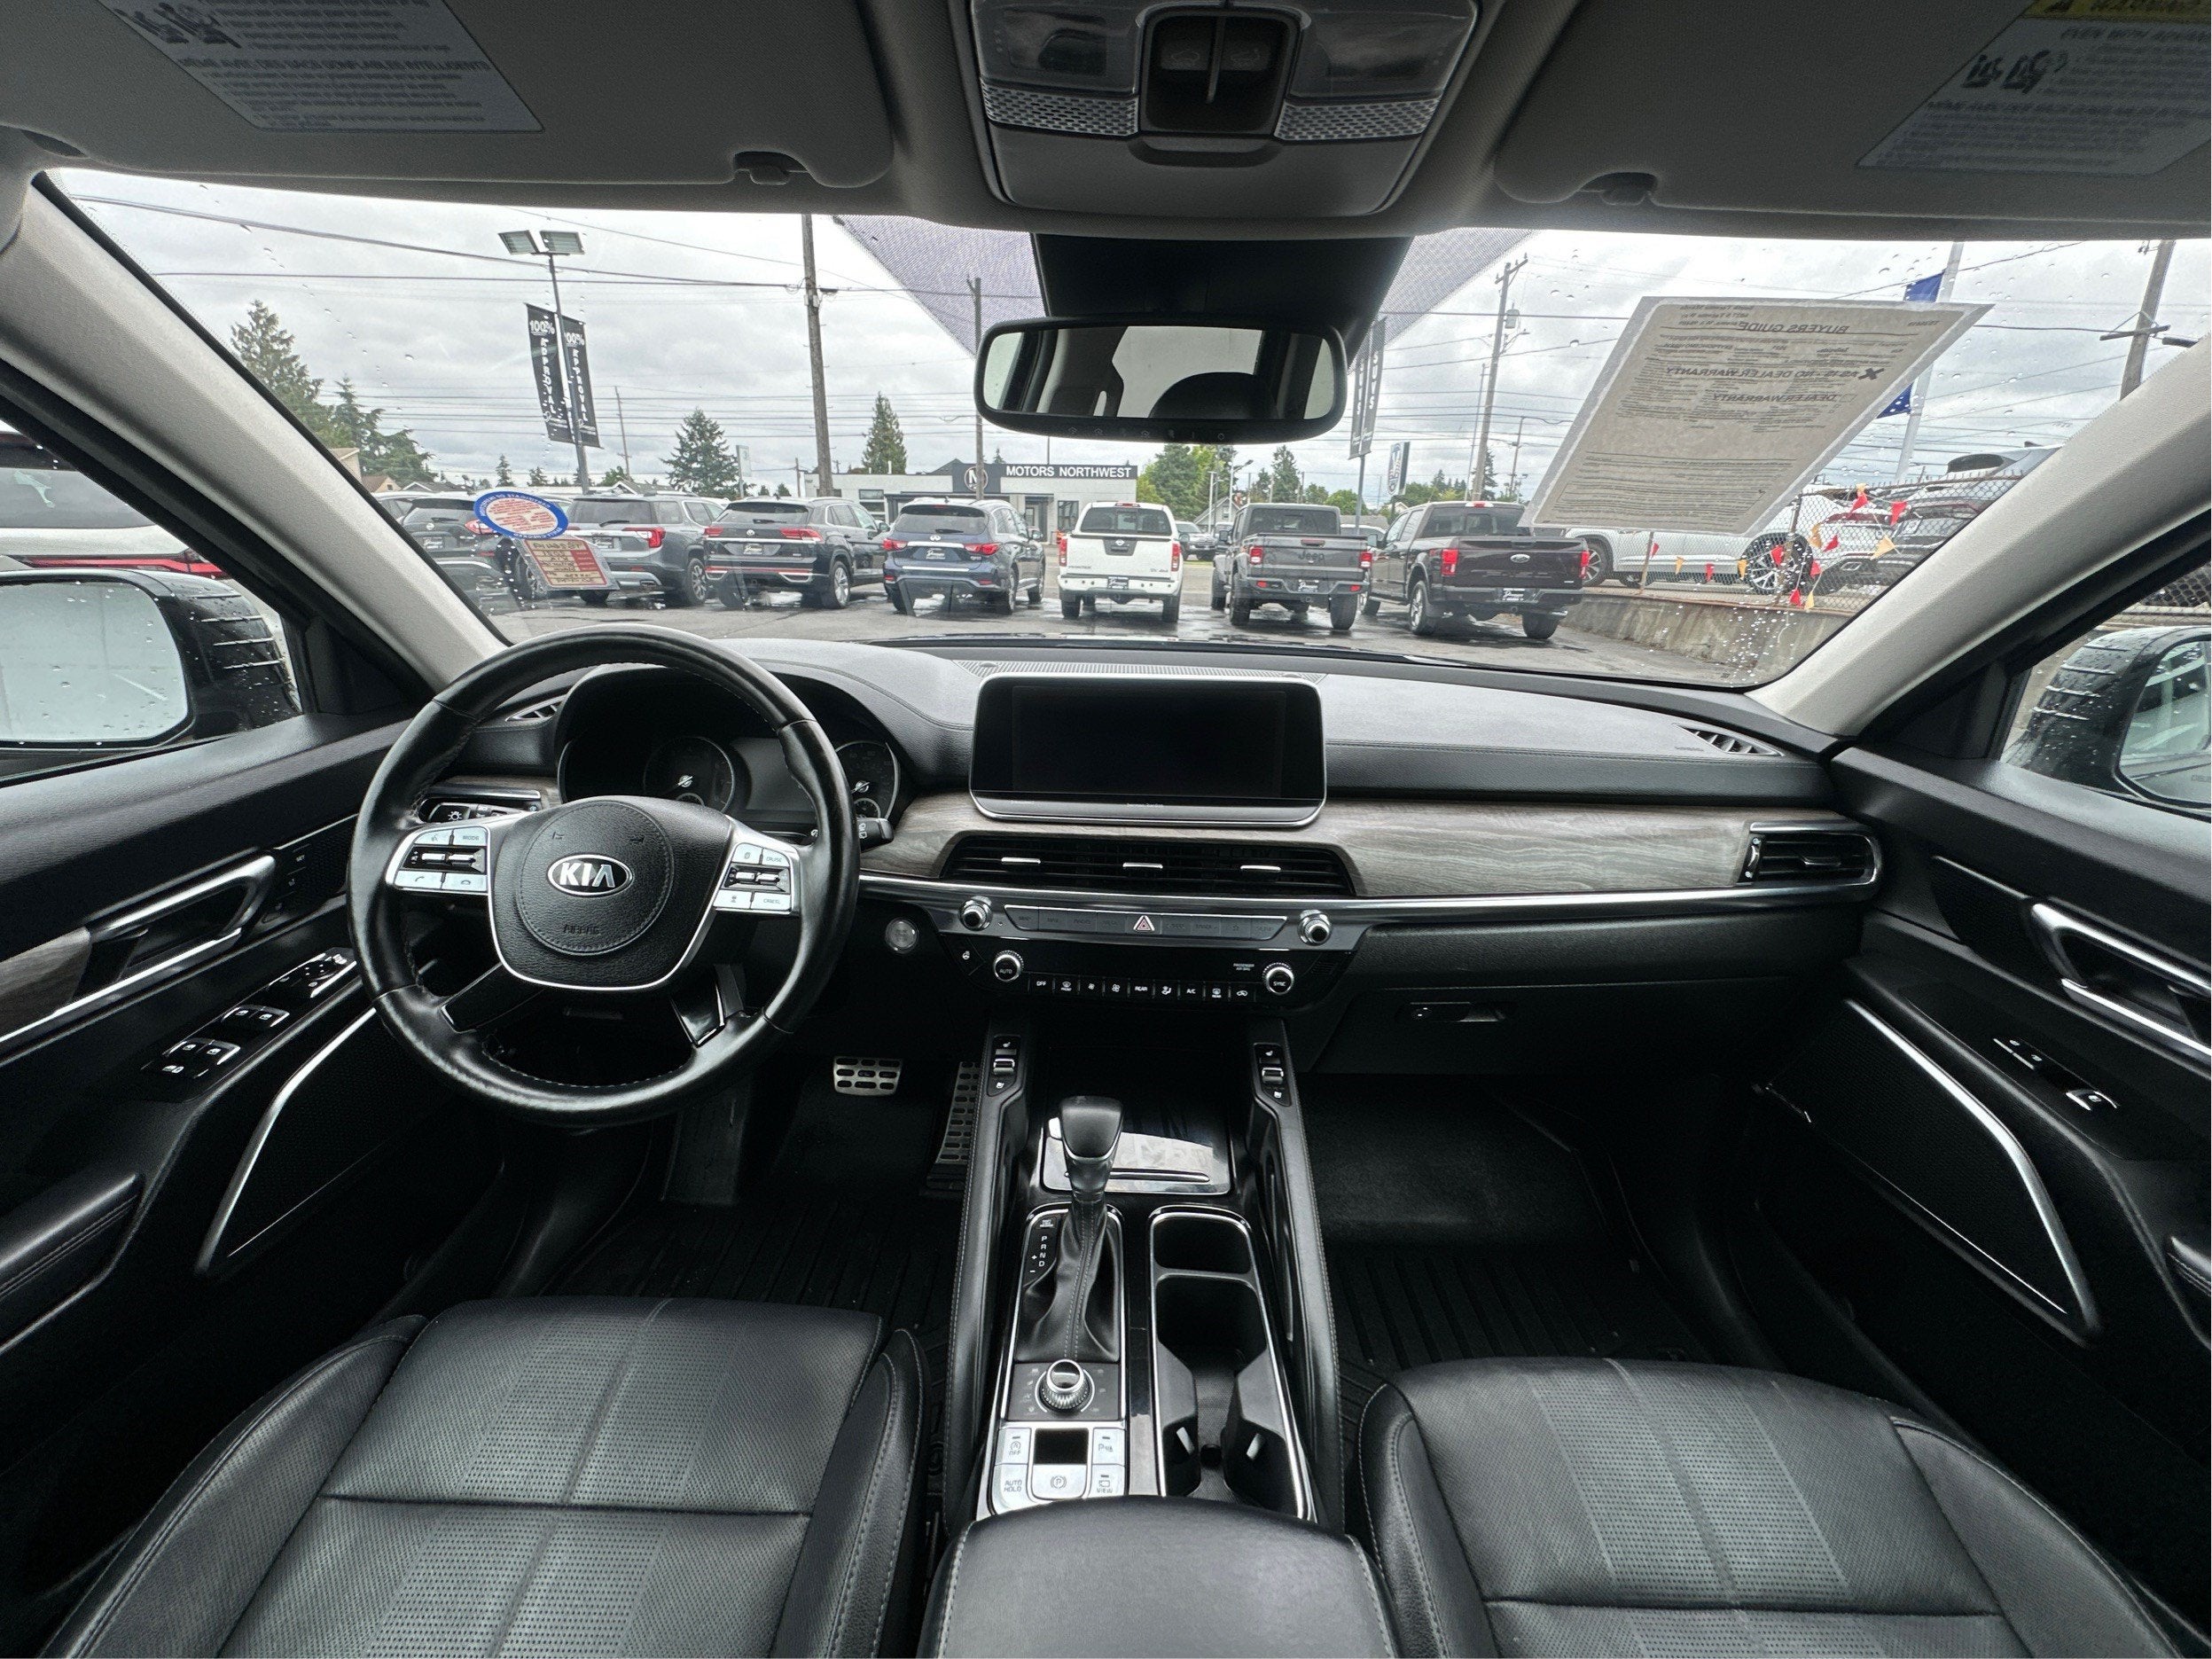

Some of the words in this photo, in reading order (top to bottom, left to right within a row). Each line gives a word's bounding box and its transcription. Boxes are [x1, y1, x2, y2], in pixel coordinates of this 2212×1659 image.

[1006, 466, 1055, 477] MOTORS
[1059, 466, 1132, 478] NORTHWEST
[1297, 550, 1325, 562] Jeep
[559, 861, 616, 888] KIA
